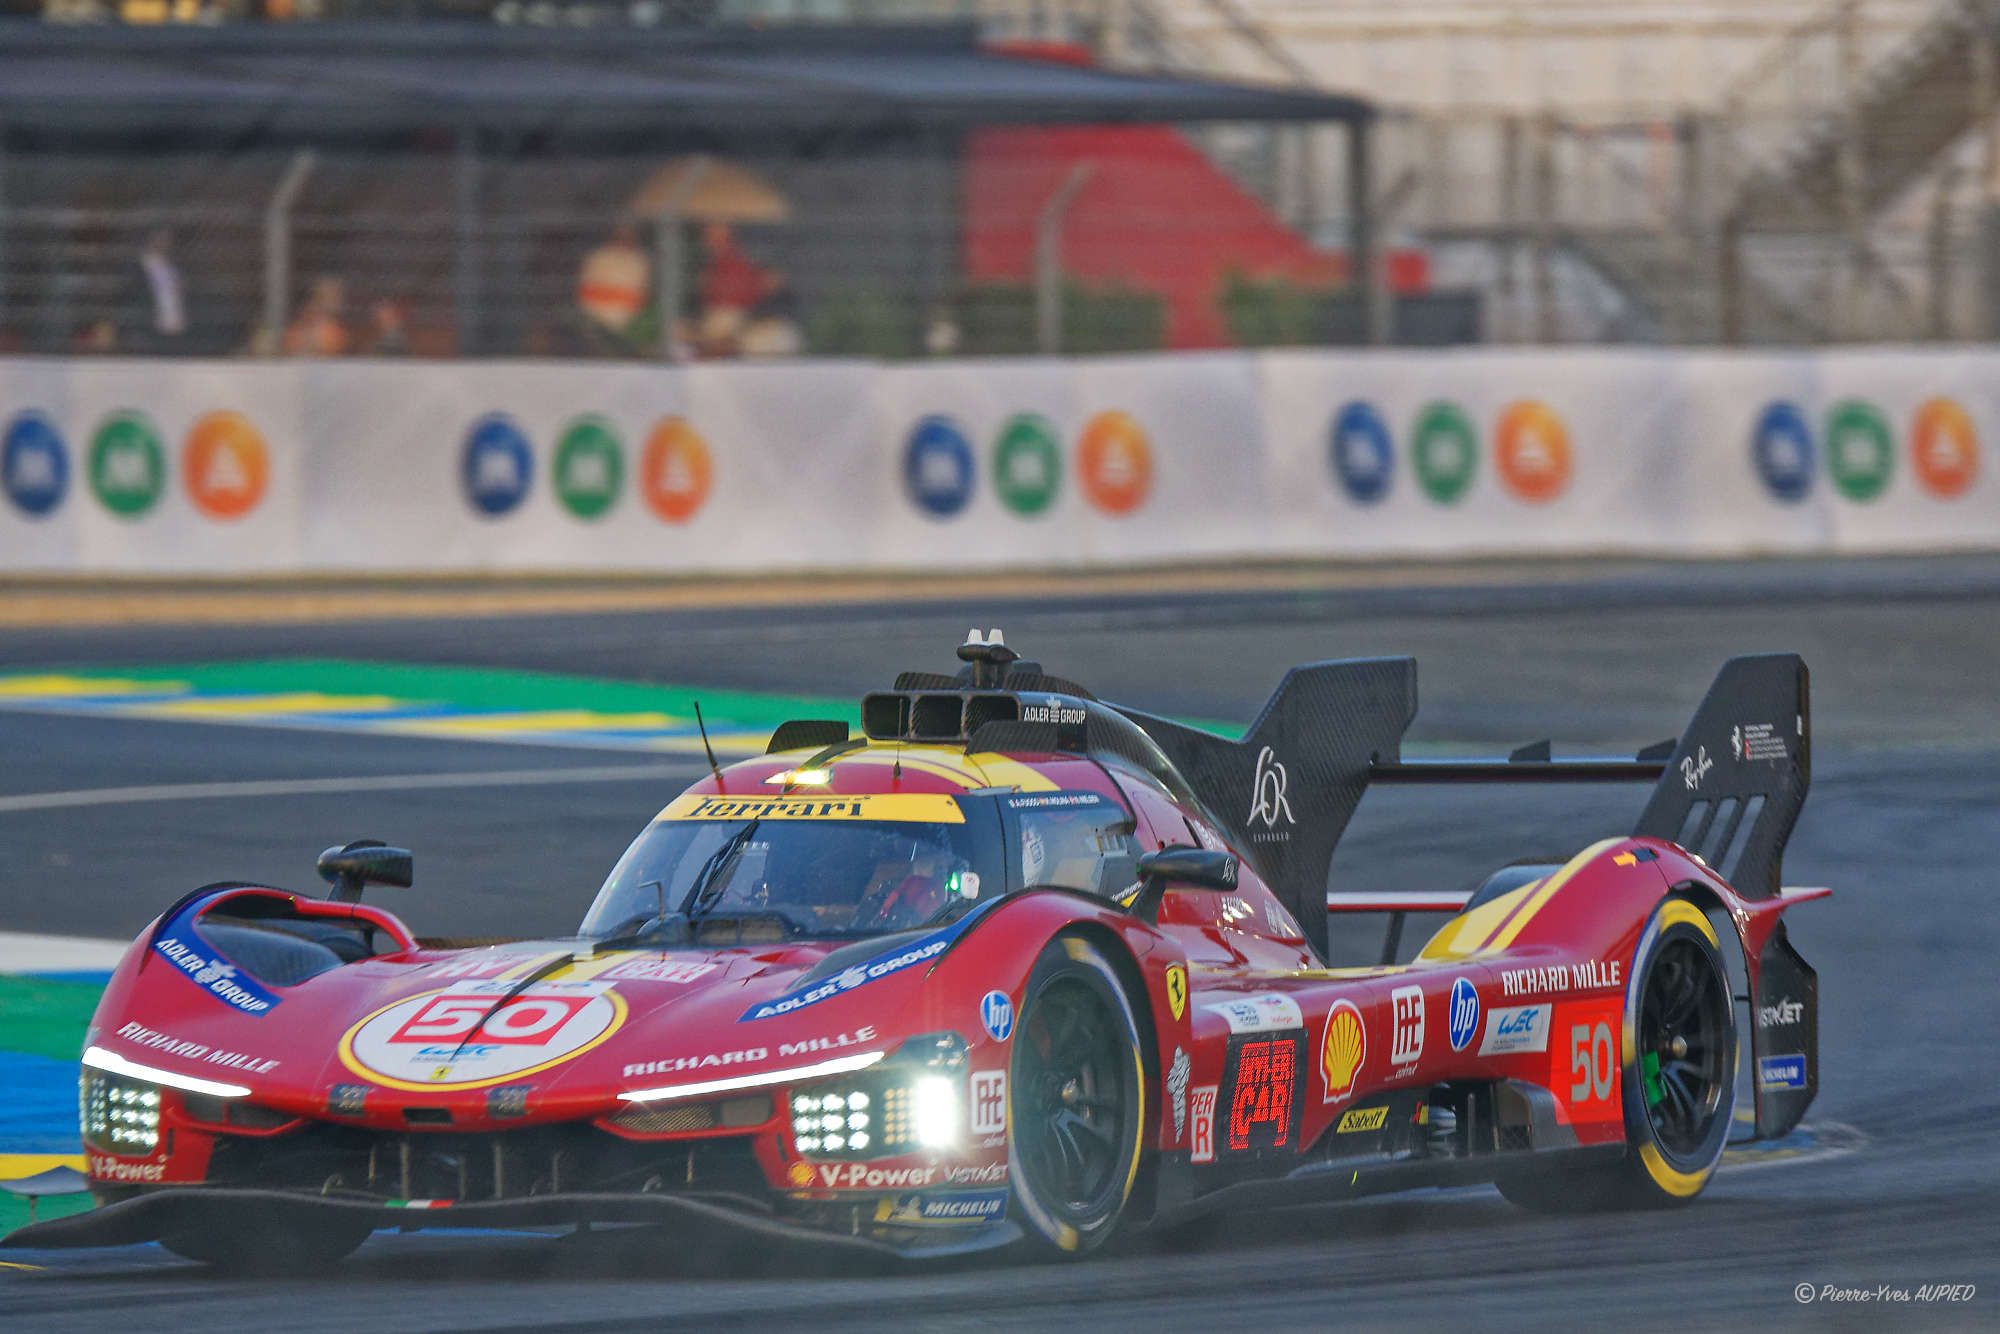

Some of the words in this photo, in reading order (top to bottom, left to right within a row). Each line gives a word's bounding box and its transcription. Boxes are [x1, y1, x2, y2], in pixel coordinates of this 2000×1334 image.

[1024, 706, 1049, 723] ADLER
[1061, 708, 1086, 725] GROUP
[683, 796, 871, 818] Ferrari
[155, 938, 205, 973] ADLER
[210, 978, 270, 1012] GROUP
[755, 983, 838, 1018] ADLER
[867, 941, 947, 977] GROUP
[1501, 966, 1568, 996] RICHARD
[1572, 960, 1620, 990] MILLE
[403, 1000, 569, 1038] 50
[989, 992, 1010, 1040] hp
[1453, 979, 1476, 1049] hp
[116, 1020, 209, 1059] RICHARD
[203, 1050, 281, 1074] MILLE
[623, 1047, 768, 1078] RICHARD
[778, 1025, 877, 1057] MILLE
[1571, 1021, 1614, 1102] 50
[819, 1163, 937, 1188] V-Power
[924, 1199, 1003, 1216] MICHELIN
